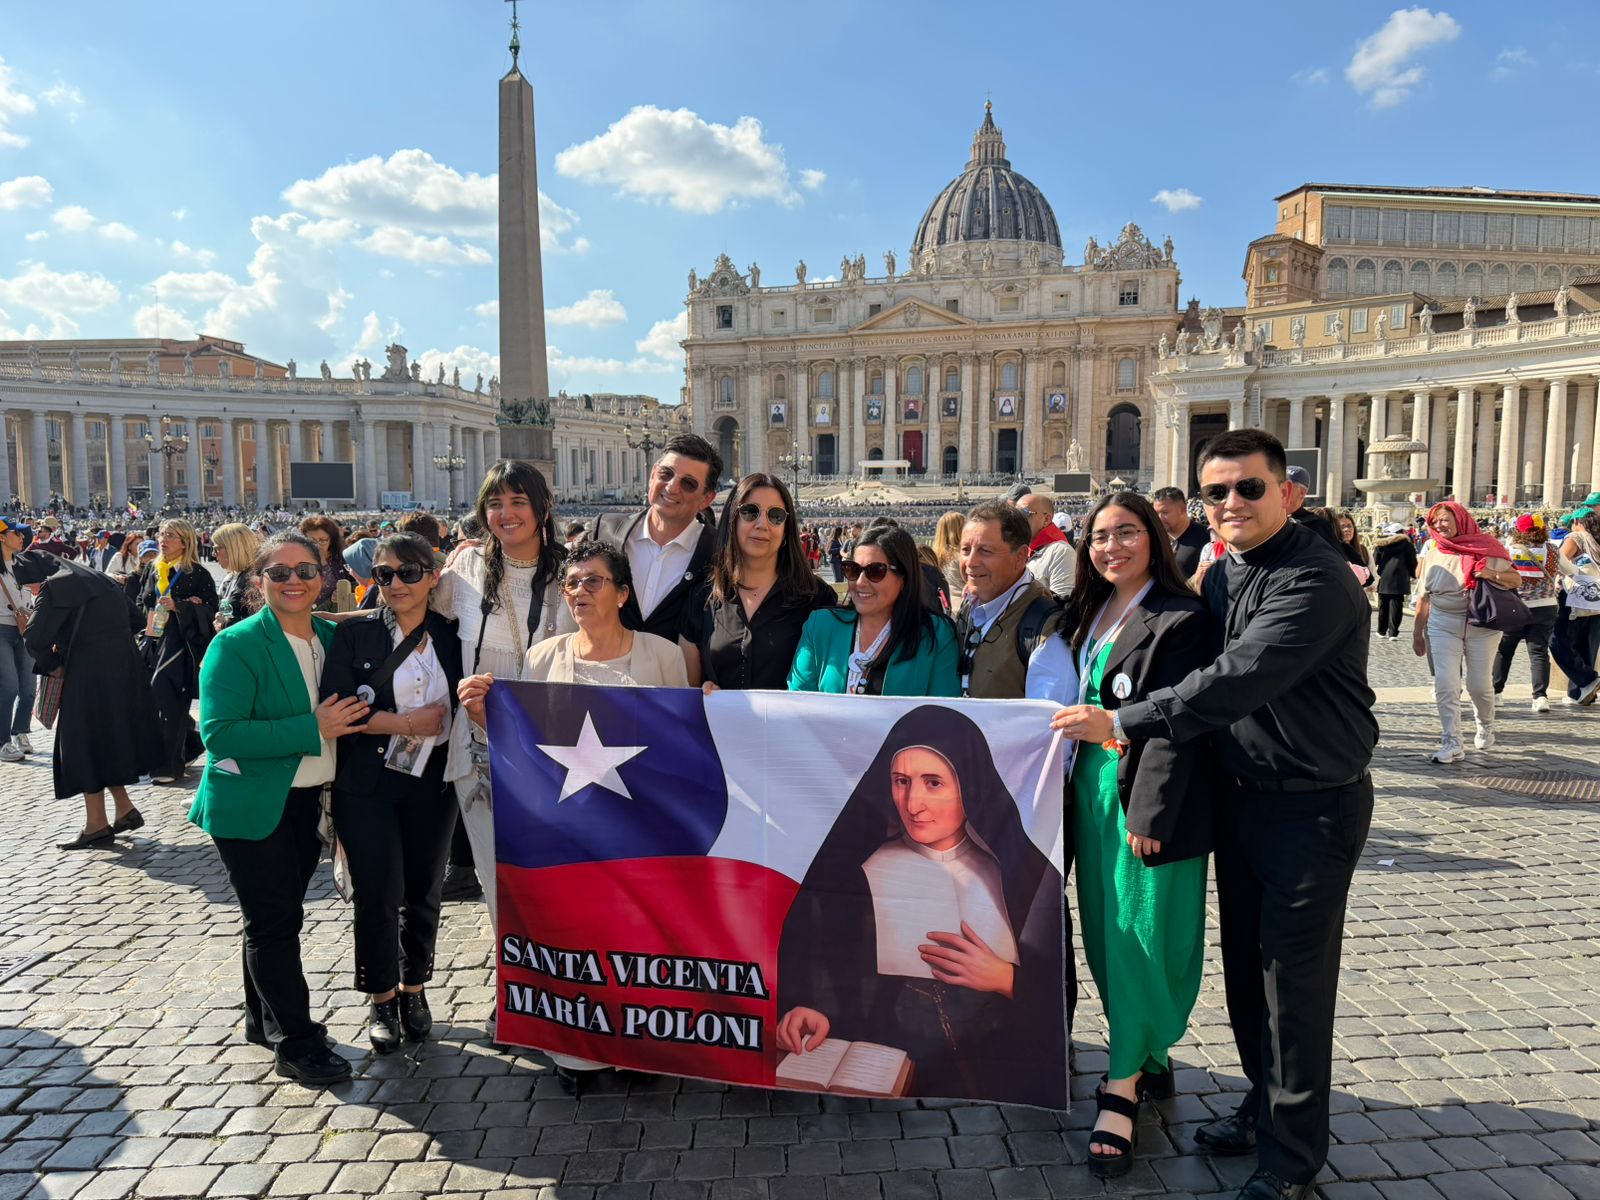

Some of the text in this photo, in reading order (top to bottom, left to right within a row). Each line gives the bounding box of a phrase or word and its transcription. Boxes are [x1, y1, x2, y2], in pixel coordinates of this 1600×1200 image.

[502, 935, 767, 998] SANTA VICENTA
[506, 983, 762, 1049] MARÍA POLONI
